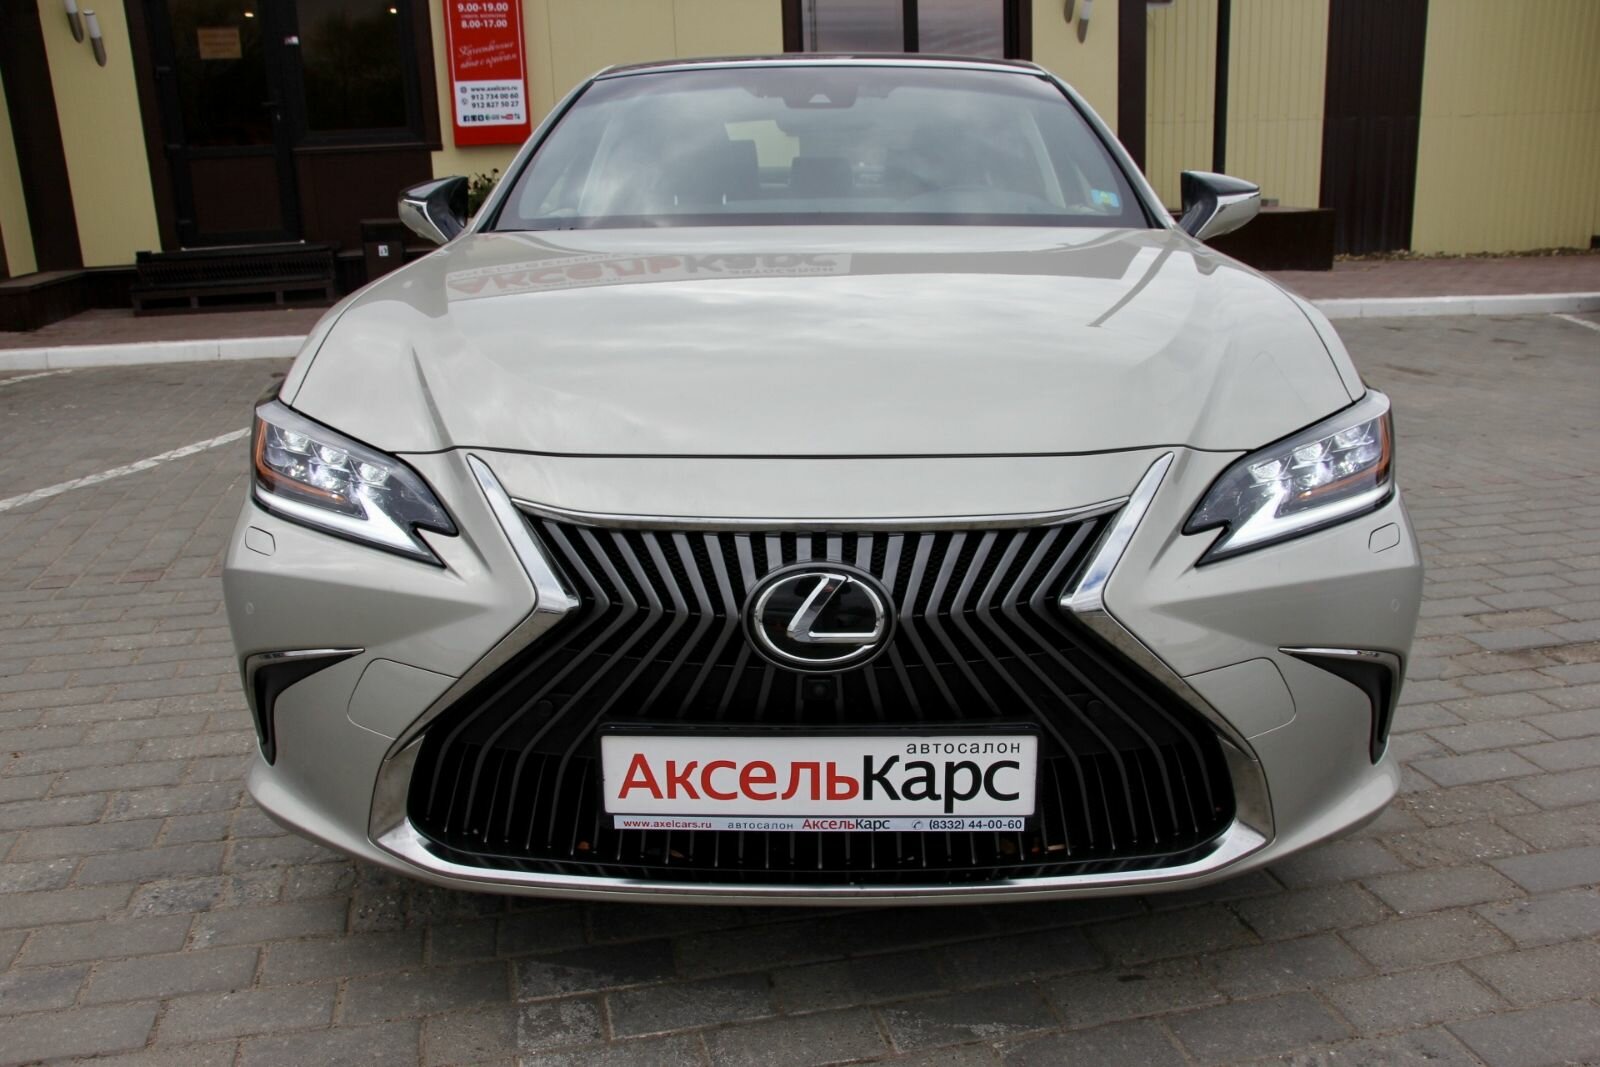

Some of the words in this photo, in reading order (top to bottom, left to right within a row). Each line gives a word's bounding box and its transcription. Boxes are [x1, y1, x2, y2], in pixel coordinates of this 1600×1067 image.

[457, 2, 508, 12] 9.00-19.00
[461, 19, 508, 29] 8.00-17.00
[906, 742, 1021, 755] автосалон
[617, 753, 1020, 814] АксельКарс
[623, 820, 712, 829] www.axelcars.ru
[728, 821, 794, 830] автосалон
[802, 819, 891, 831] АксельКарс
[929, 819, 965, 831] (8332)
[968, 819, 1022, 830] 44-00-60
